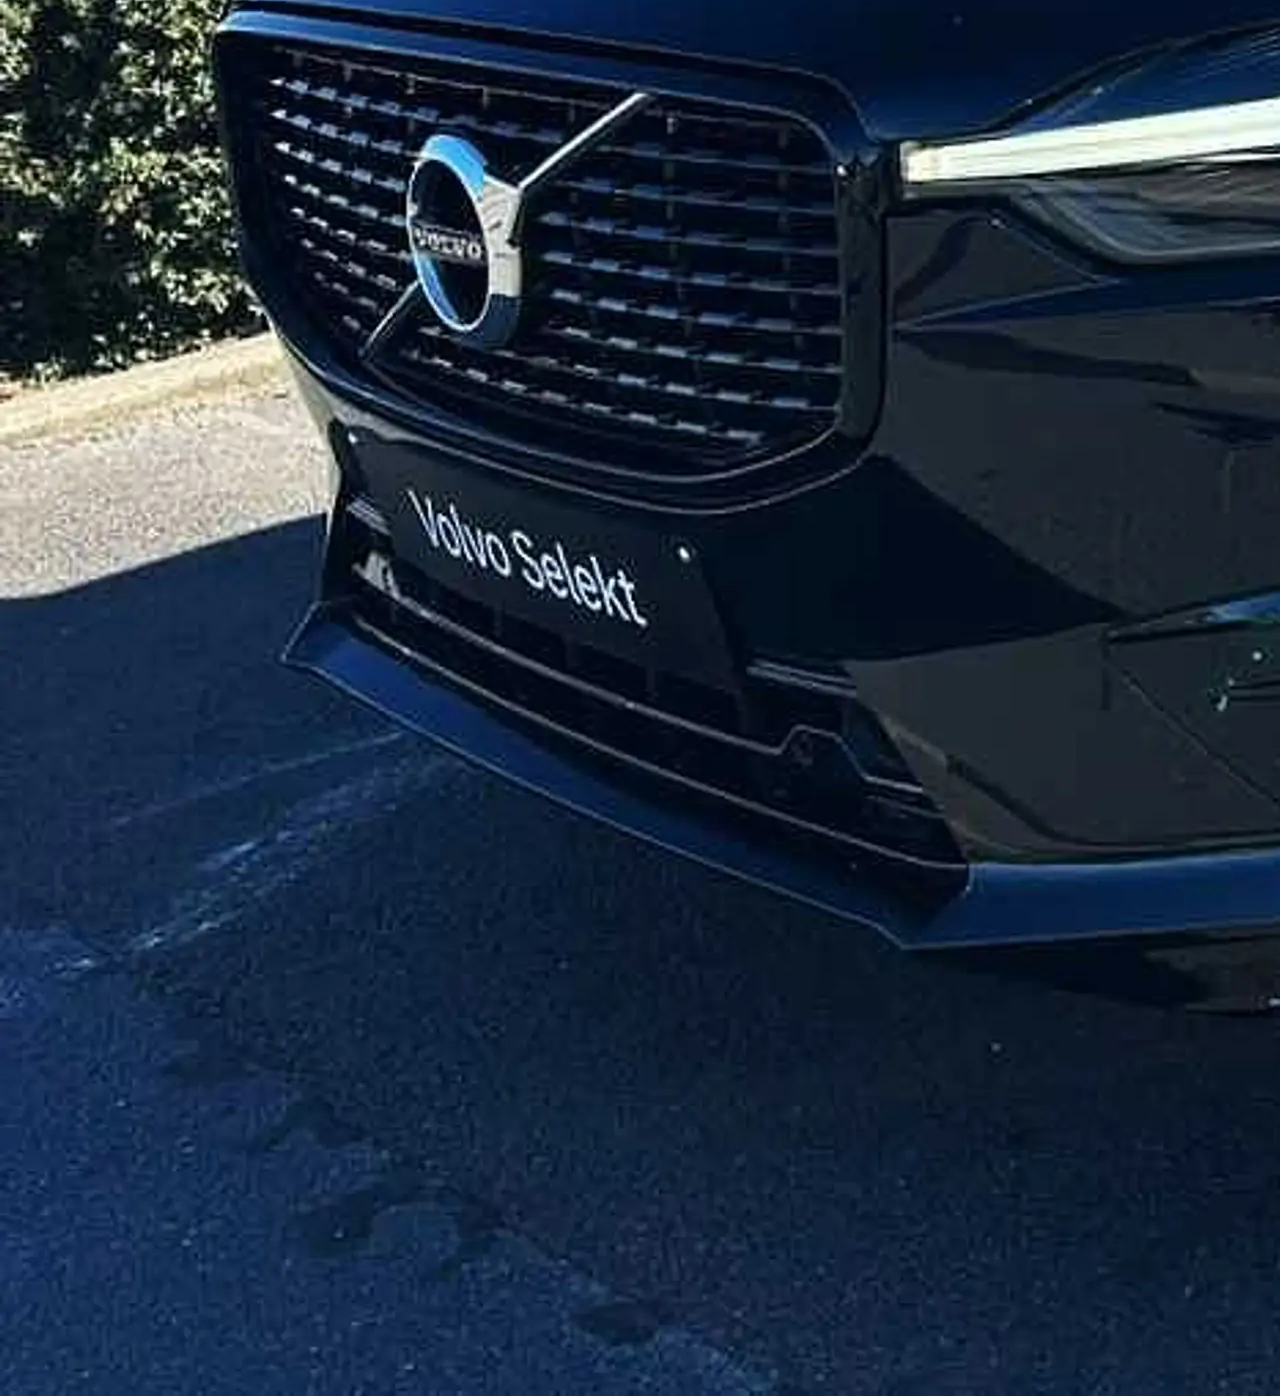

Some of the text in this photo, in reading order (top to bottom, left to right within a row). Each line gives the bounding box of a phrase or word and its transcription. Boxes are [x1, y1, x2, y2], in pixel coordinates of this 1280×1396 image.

[412, 226, 482, 260] VOLVO
[406, 488, 649, 628] Volvo Selekt
